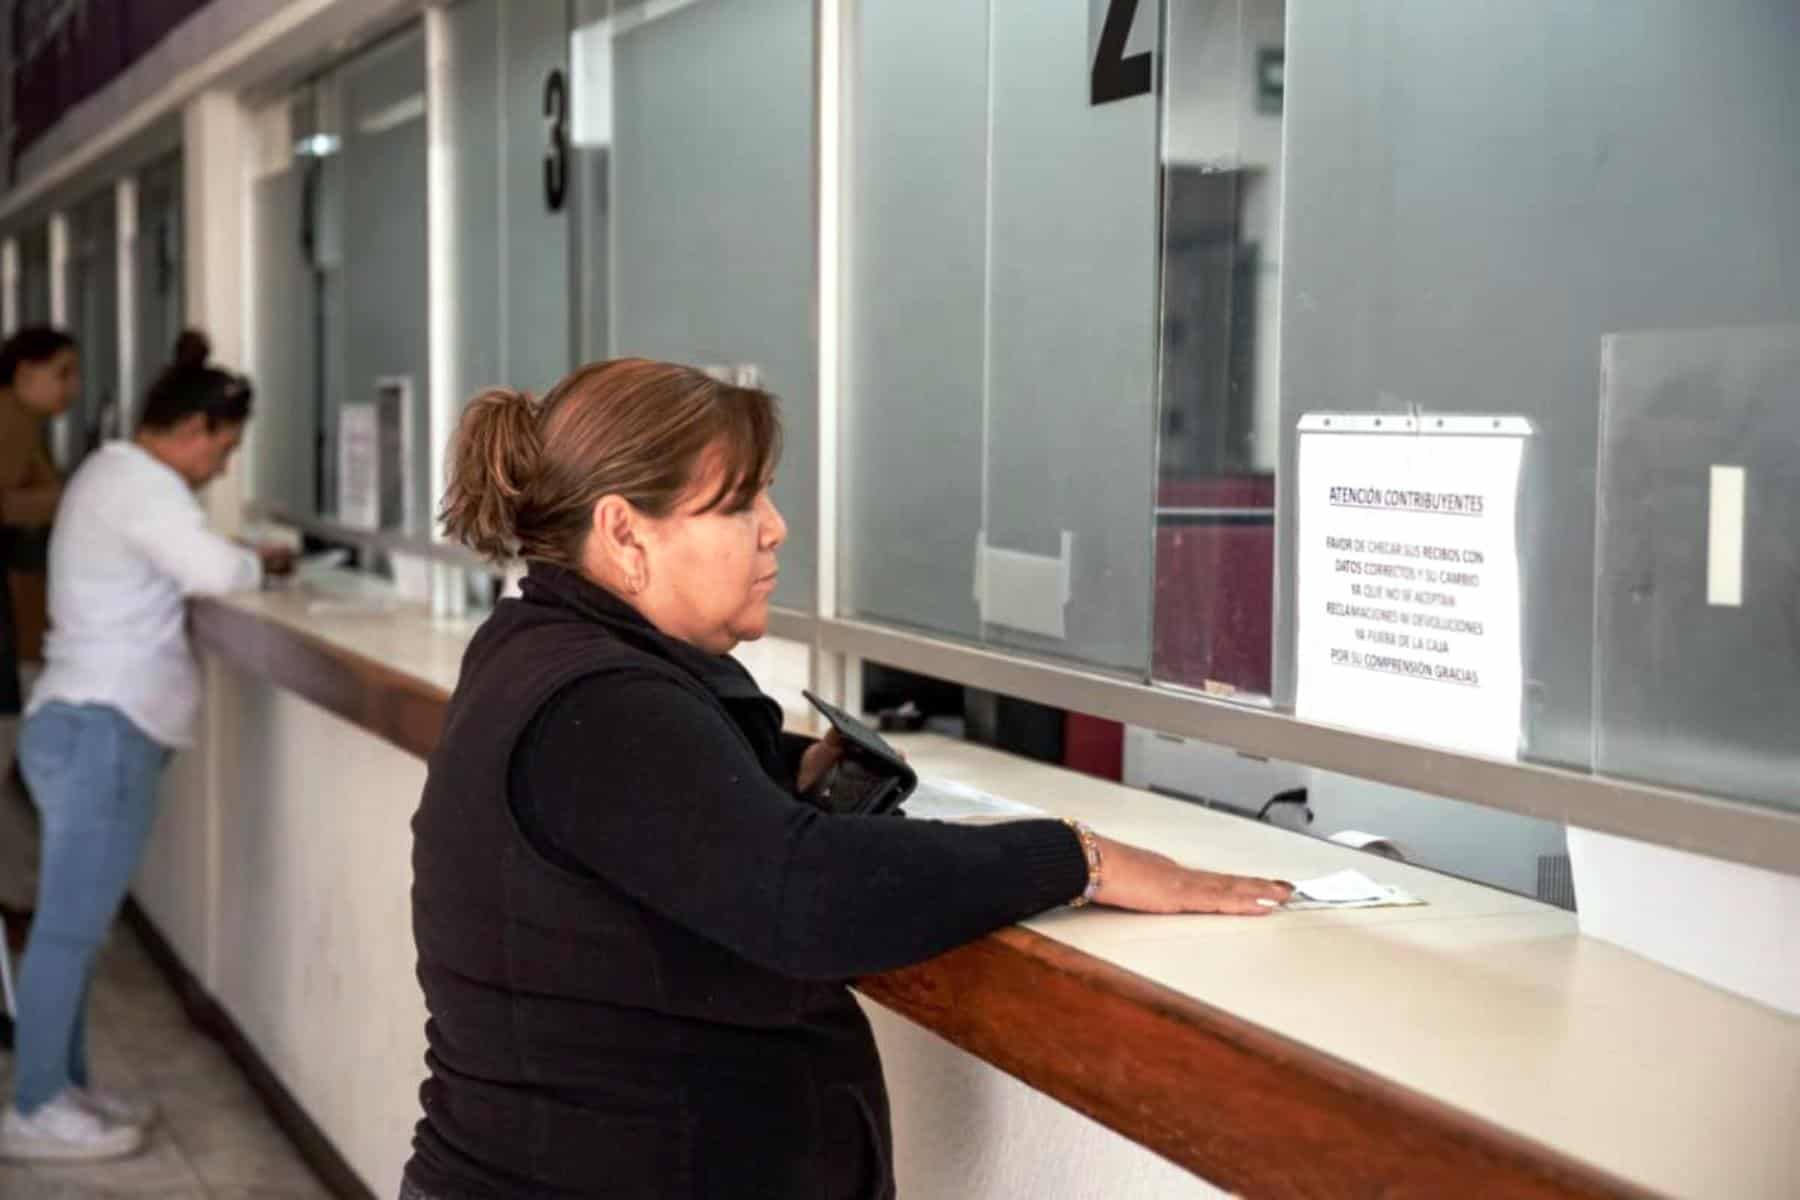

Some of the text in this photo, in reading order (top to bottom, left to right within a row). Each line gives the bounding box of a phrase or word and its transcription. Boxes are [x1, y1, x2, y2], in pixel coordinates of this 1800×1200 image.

[544, 69, 567, 213] 3
[1329, 485, 1483, 513] ATENCIÓN CONTRIBUYENTES
[1326, 535, 1353, 552] FAVOR
[1354, 538, 1366, 553] DE
[1367, 539, 1402, 556] CHECAR
[1422, 545, 1461, 563] RECIBOS
[1462, 549, 1485, 564] CON
[1335, 558, 1362, 575] DATOS
[1363, 561, 1417, 581] CORRECTOS
[1326, 601, 1398, 624] RECLAMACIONES
[1412, 612, 1484, 636] DEVOLUCIONES
[1367, 629, 1396, 646] FUERA
[1398, 634, 1410, 649] DE
[1412, 637, 1424, 650] LA
[1426, 638, 1449, 654] CAJA
[1330, 648, 1479, 684] POR SU COMPRENSIÓN GRACIAS
